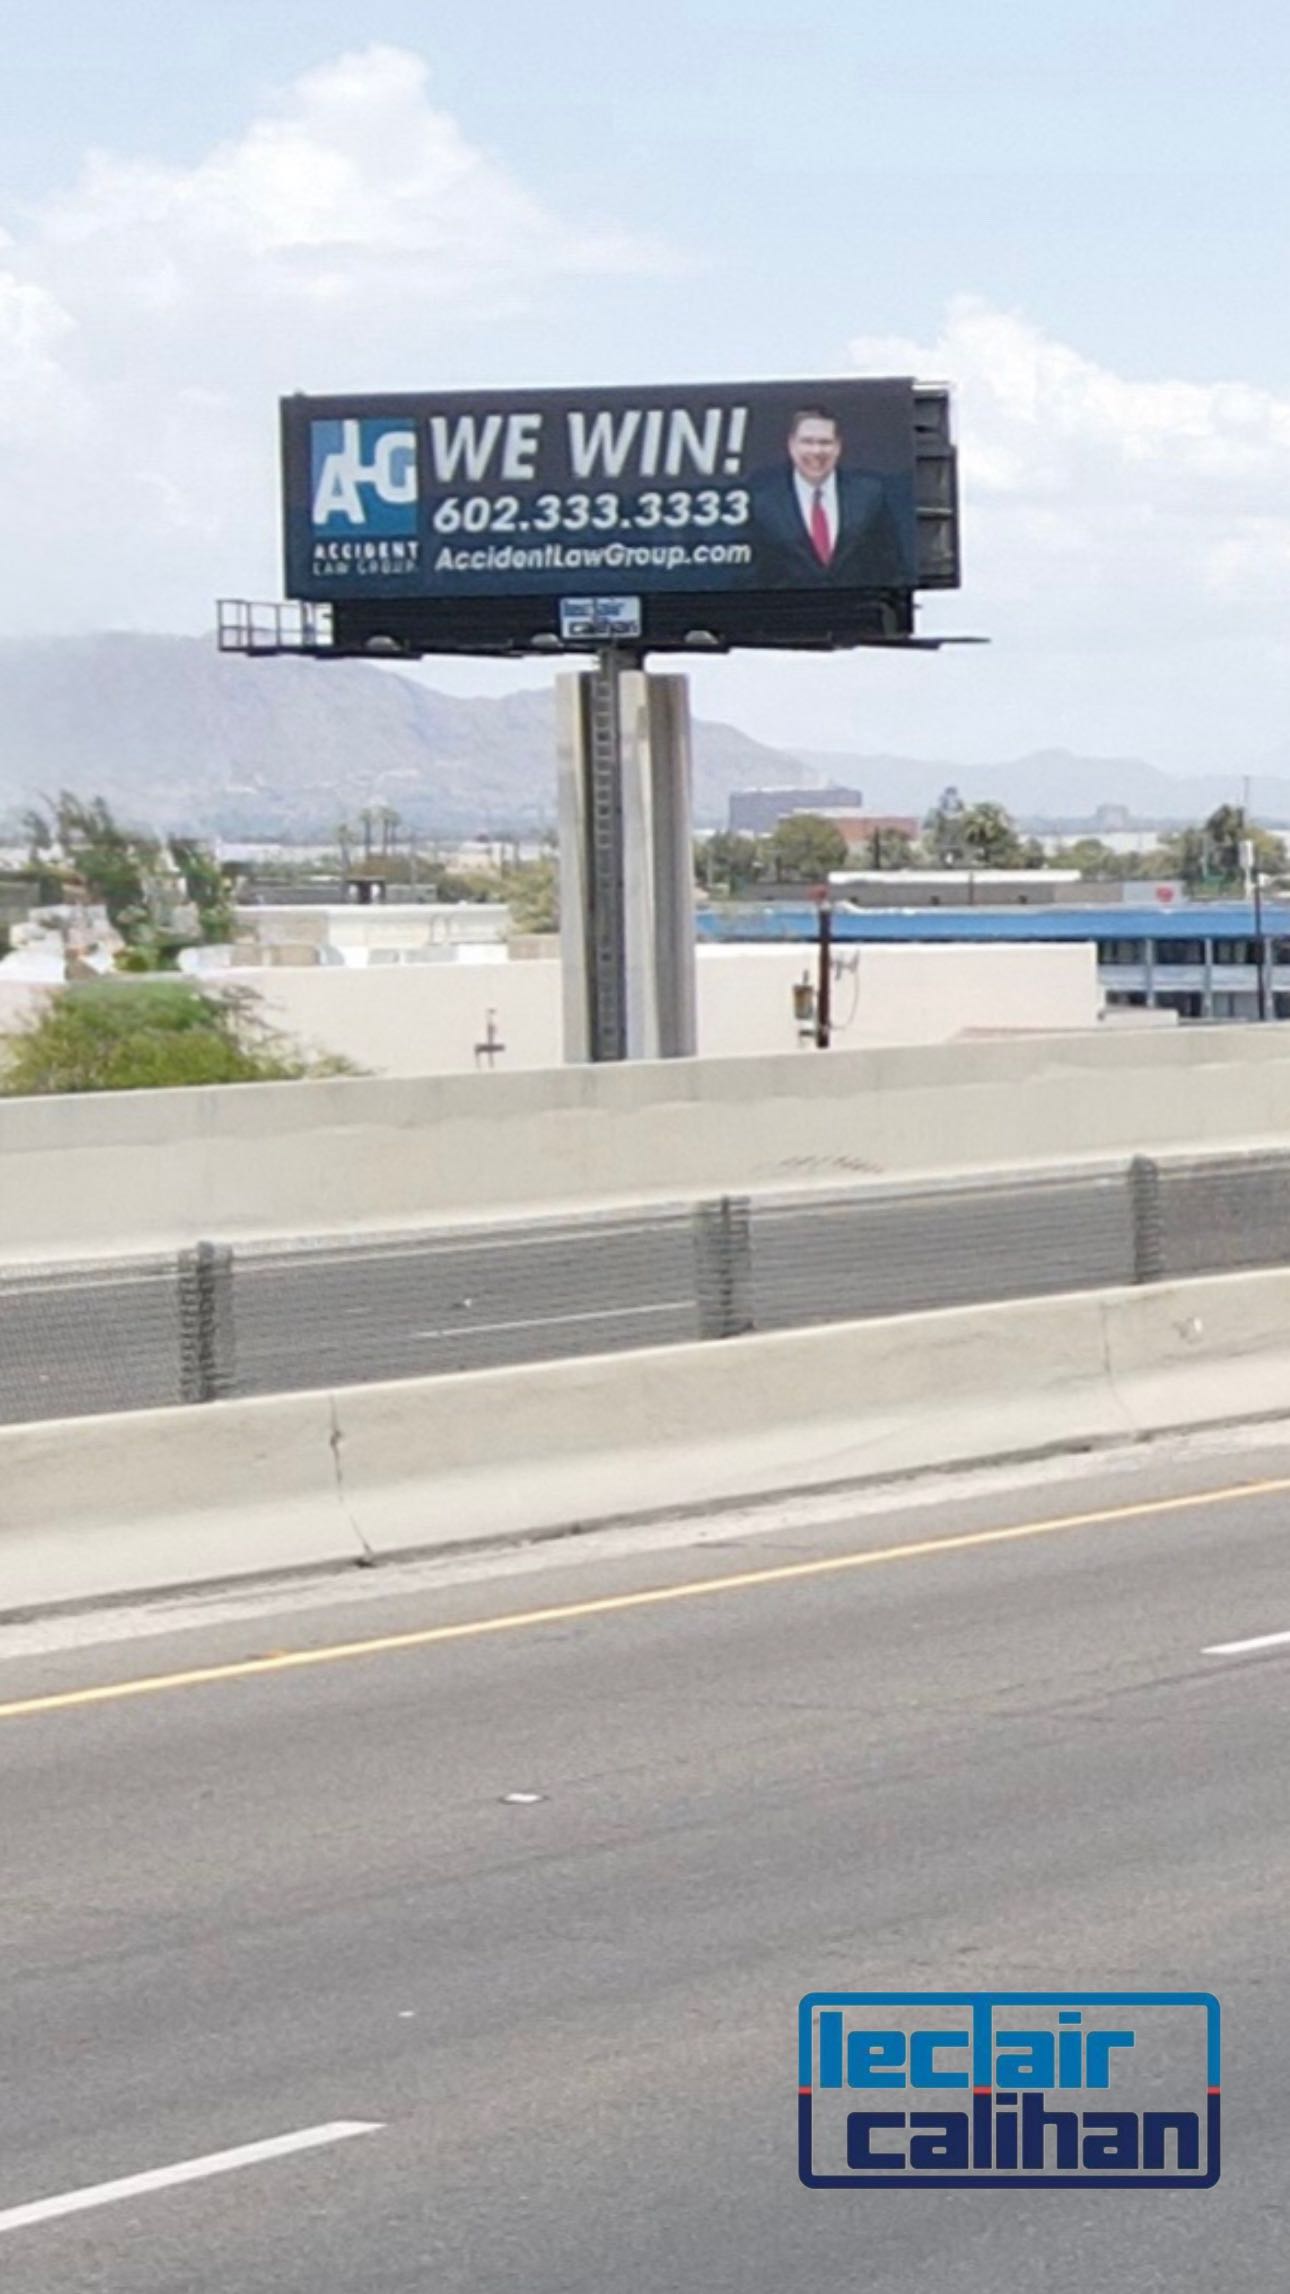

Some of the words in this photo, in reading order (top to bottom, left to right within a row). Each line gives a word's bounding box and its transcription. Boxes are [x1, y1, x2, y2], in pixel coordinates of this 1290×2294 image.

[430, 414, 542, 482] WE
[567, 407, 748, 478] WIN!
[433, 490, 750, 533] 602.333.3333
[314, 541, 419, 560] ACCIDENT
[434, 543, 751, 571] AccidentLawGroup.com
